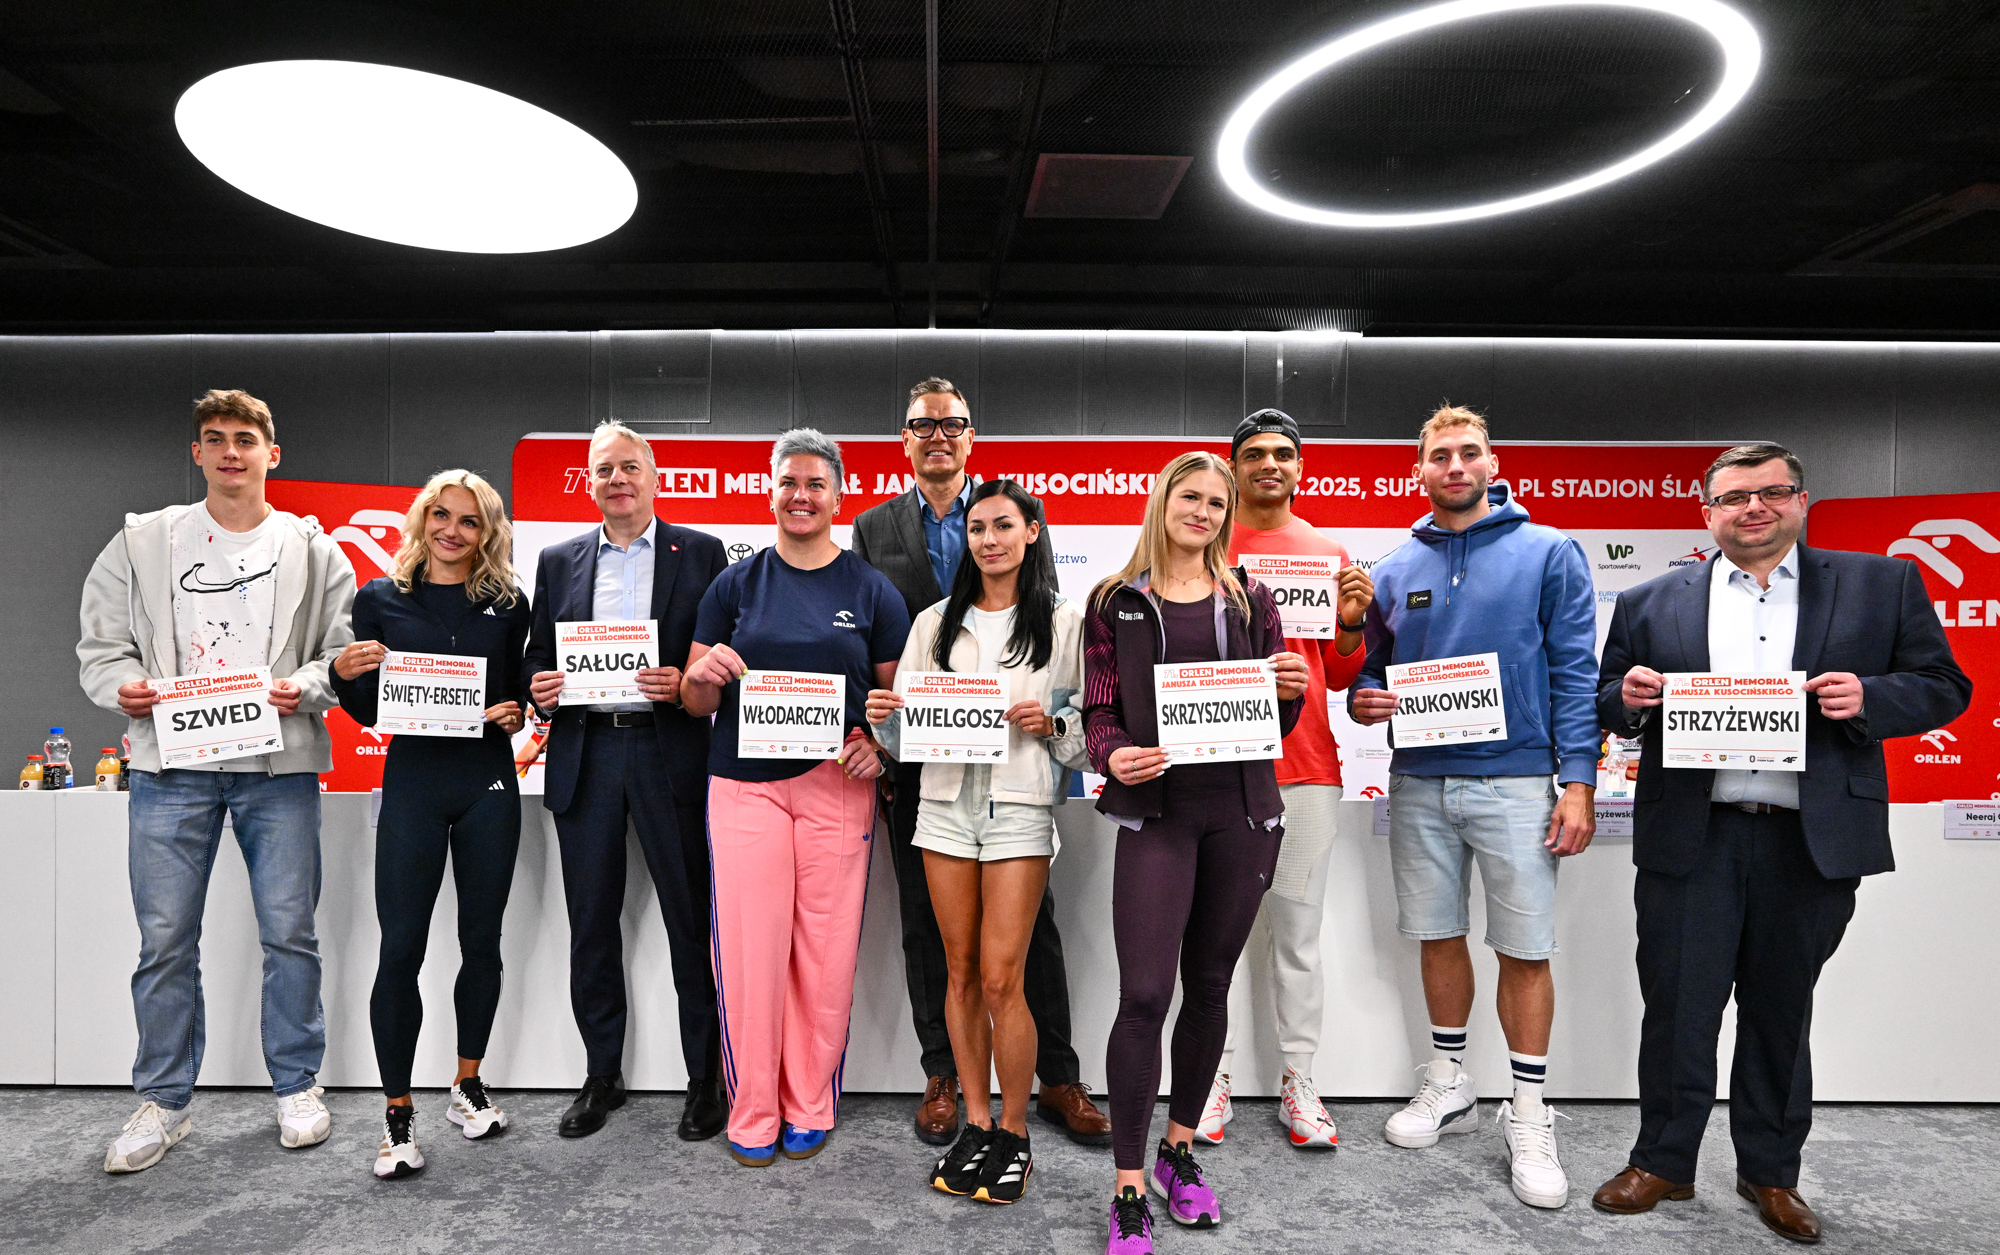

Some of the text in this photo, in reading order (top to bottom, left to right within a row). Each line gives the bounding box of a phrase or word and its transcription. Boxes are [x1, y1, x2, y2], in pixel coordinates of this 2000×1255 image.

[1552, 478, 1654, 498] STADION
[1606, 544, 1634, 560] WP
[1270, 588, 1331, 607] OPRA
[436, 660, 475, 668] MEMORIAŁ
[566, 653, 650, 673] SAŁUGA
[1410, 665, 1439, 675] ORLEN
[1442, 660, 1485, 670] MEMORIAŁ
[420, 667, 478, 676] KUSOCIŃSKIEGO
[1181, 668, 1212, 677] ORLEN
[1216, 666, 1261, 675] MEMORIAŁ
[1393, 669, 1490, 686] JANUSZA KUSOCIŃSKIEGO
[176, 679, 209, 689] ORLEN
[213, 673, 258, 684] MEMORIAŁ
[197, 681, 263, 695] KUSOCIŃSKIEGO
[1162, 676, 1266, 688] JANUSZA KUSOCIŃSKIEGO
[383, 680, 480, 706] ŚWIĘTY-ERSETIC
[779, 686, 836, 694] KUSOCIŃSKIEGO
[942, 687, 1001, 695] KUSOCIŃSKIEGO
[1395, 688, 1498, 716] KRUKOWSKI
[172, 702, 262, 731] SZWED
[743, 705, 840, 726] WŁODARCZYK
[905, 707, 1005, 728] WIELGOSZ
[1162, 699, 1273, 726] SKRZYSZOWSKA
[1668, 705, 1799, 732] STRZYŻEWSKI
[356, 746, 388, 755] ORLE
[1914, 754, 1961, 764] ORLEN
[1966, 813, 1995, 822] Neeraj
